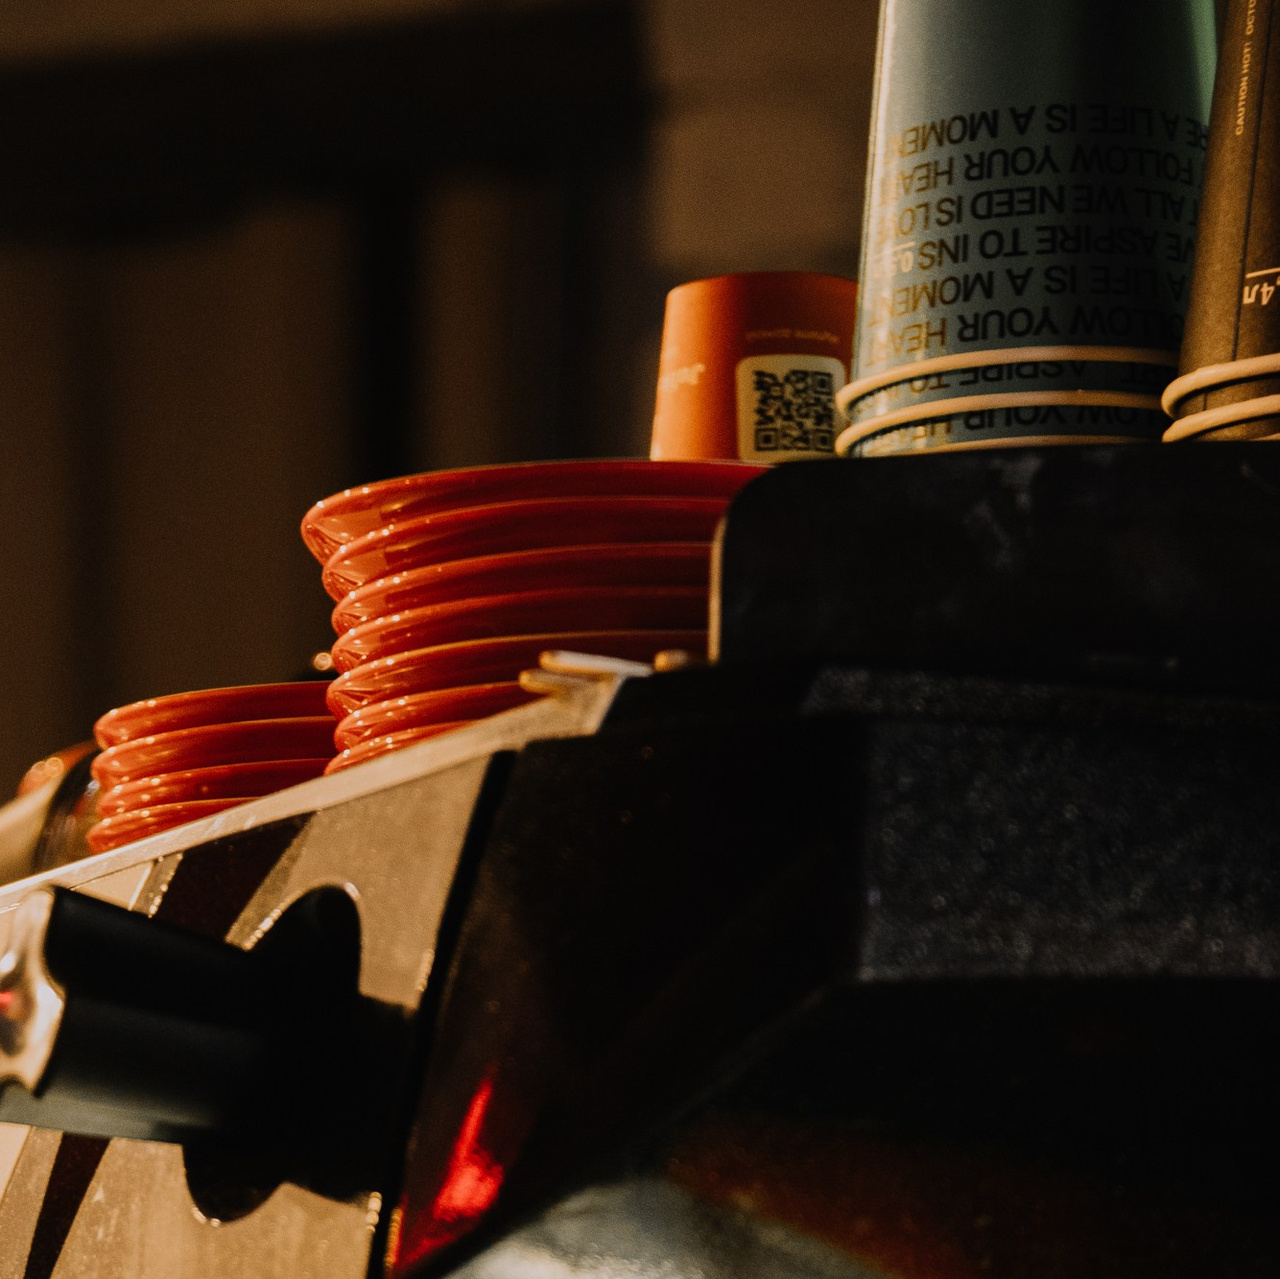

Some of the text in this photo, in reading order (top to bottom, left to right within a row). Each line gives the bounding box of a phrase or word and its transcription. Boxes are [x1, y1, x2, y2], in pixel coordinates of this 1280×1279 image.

[1008, 105, 1034, 135] A
[1045, 103, 1076, 133] IS
[1088, 103, 1153, 136] LIFE
[1235, 76, 1249, 136] CAUTION
[1161, 110, 1179, 142] A
[964, 146, 1059, 181] YOUR
[1070, 145, 1193, 185] FOLLOW
[936, 195, 963, 226] IS
[971, 185, 1064, 219] NEED
[1072, 185, 1127, 215] WE
[1135, 187, 1185, 222] ALL
[979, 228, 1028, 259] TO
[1035, 225, 1159, 256] ASPIRE
[1007, 267, 1032, 296] A
[1044, 265, 1076, 294] IS
[1167, 272, 1186, 302] A
[958, 306, 1059, 342] YOUR
[1069, 305, 1184, 342] OLLOW
